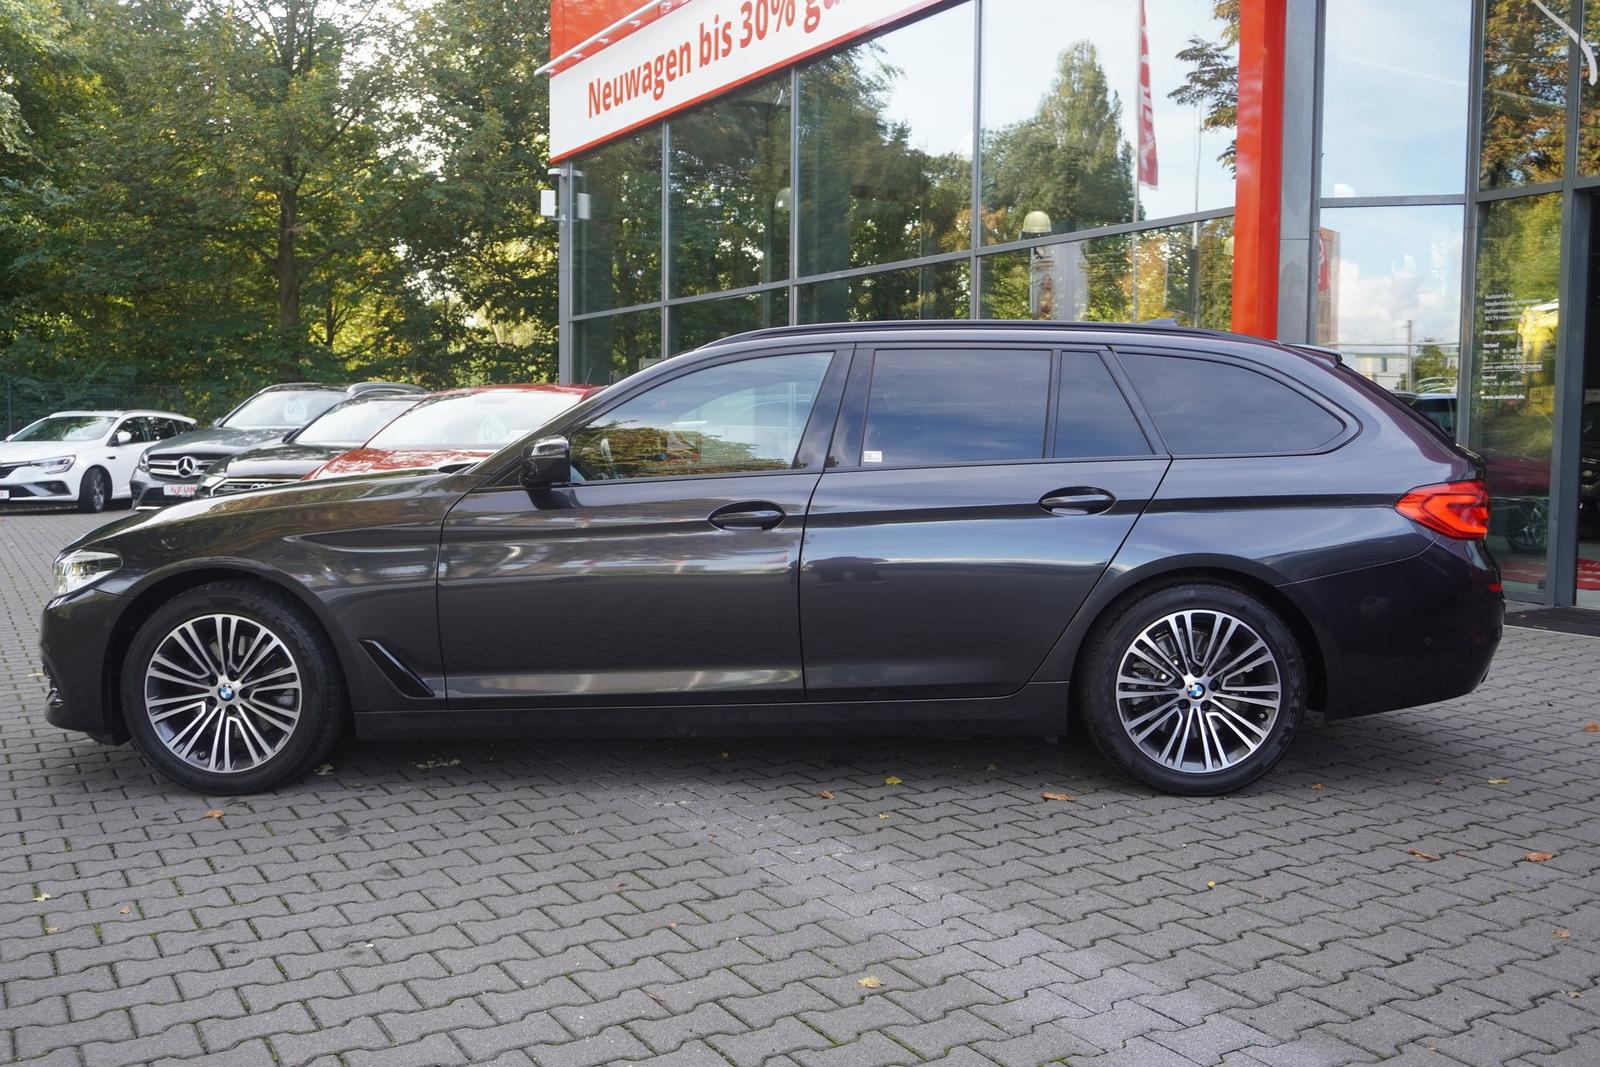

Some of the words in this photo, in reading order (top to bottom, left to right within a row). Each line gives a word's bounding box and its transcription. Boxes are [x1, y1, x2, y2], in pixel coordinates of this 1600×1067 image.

[588, 43, 691, 118] Neuwagen
[699, 14, 732, 67] bis
[739, 0, 796, 48] 30%
